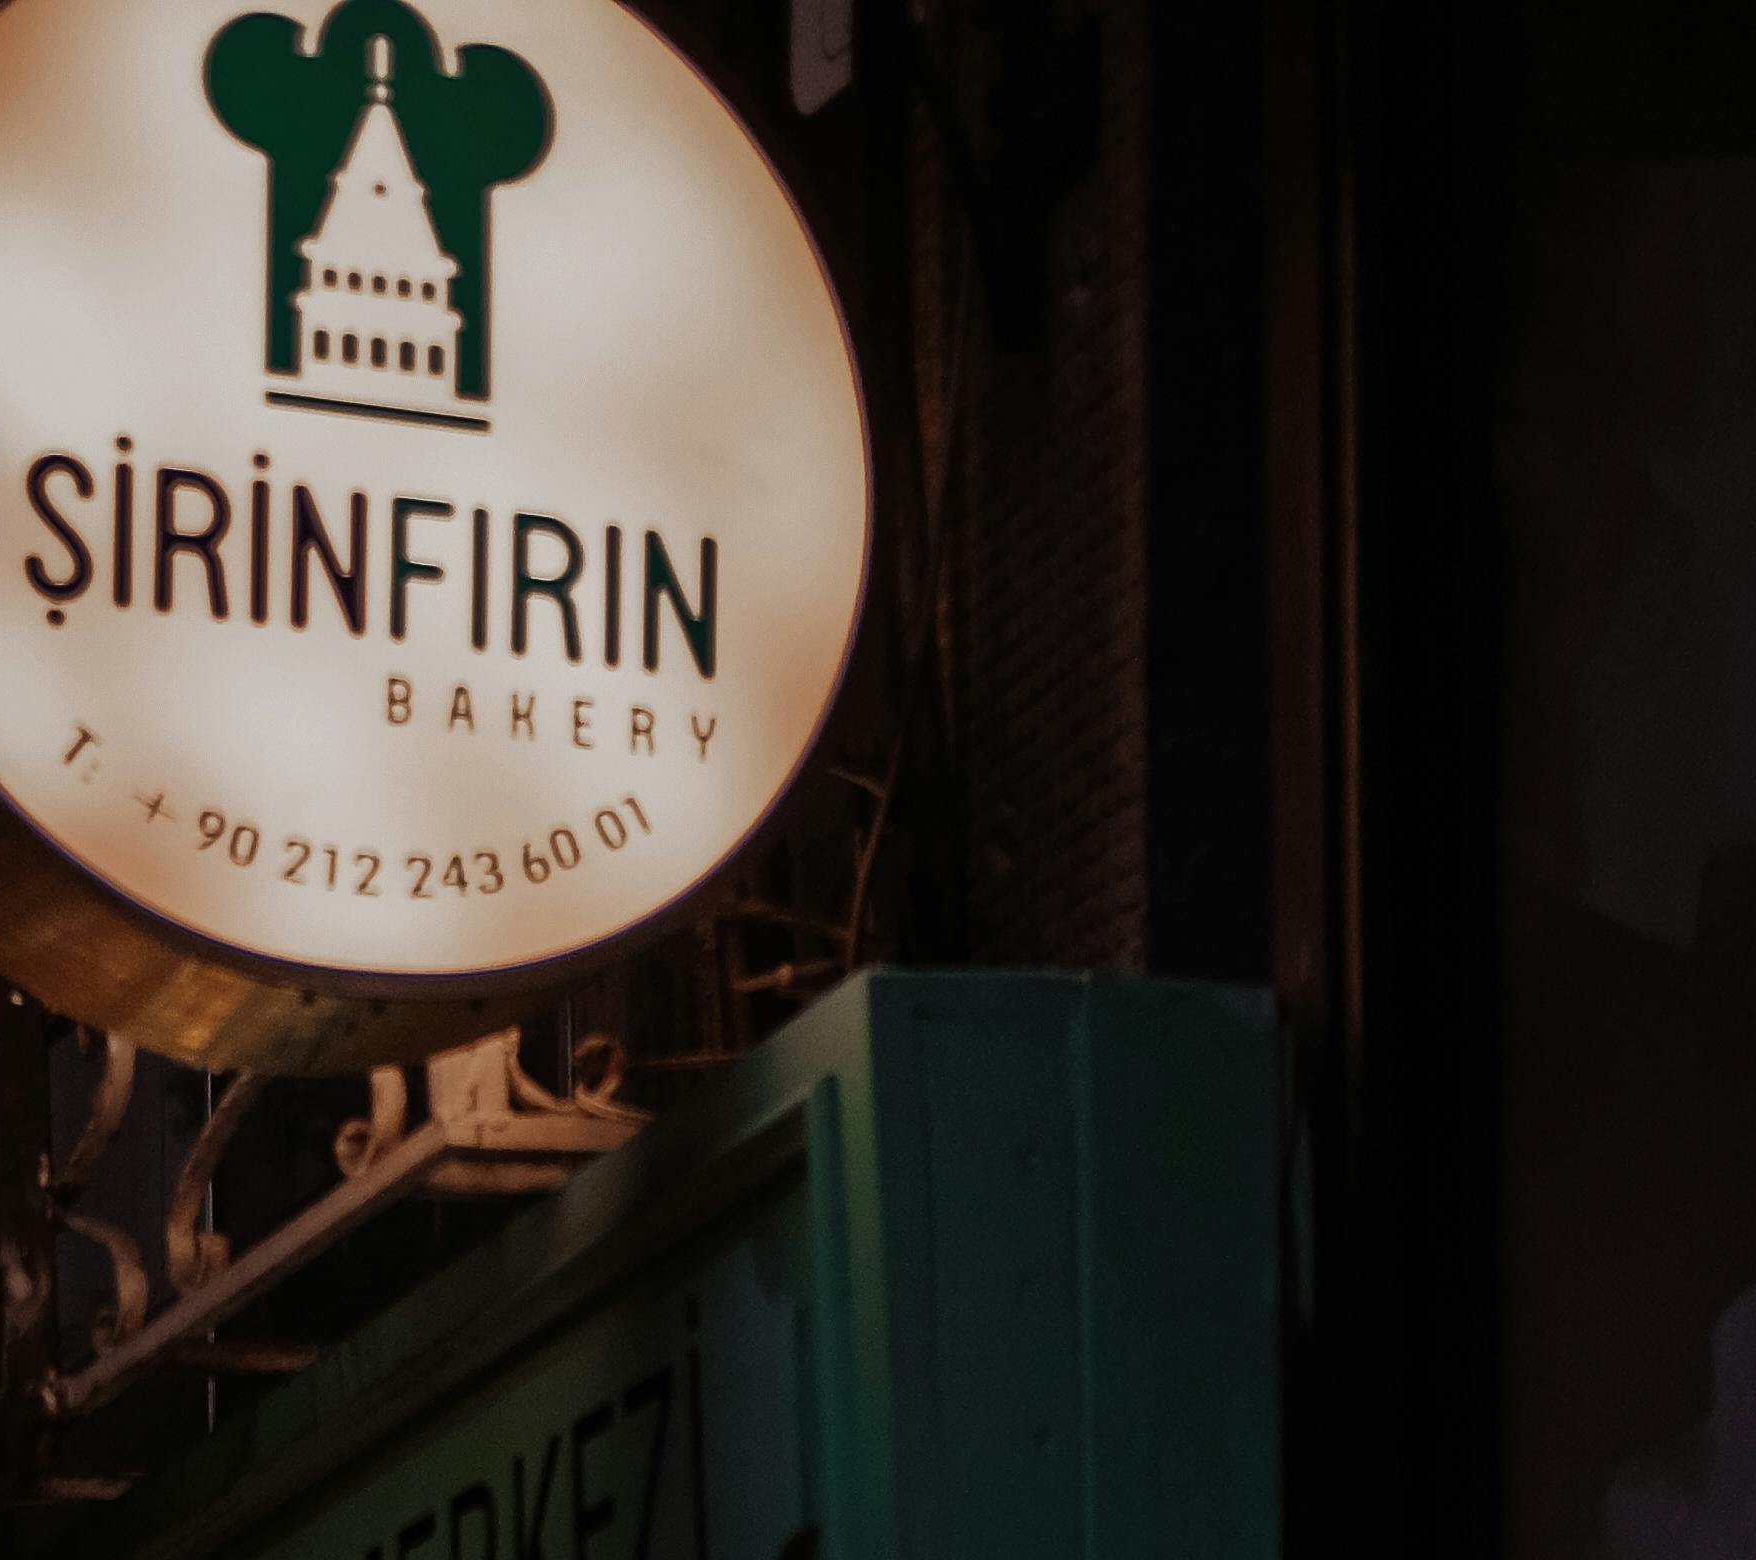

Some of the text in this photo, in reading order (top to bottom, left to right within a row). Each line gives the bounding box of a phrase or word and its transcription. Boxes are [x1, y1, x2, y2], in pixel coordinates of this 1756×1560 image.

[24, 435, 720, 680] ŞİRİNFIRIN
[387, 677, 717, 761] BAKERY
[282, 840, 382, 897] 212
[406, 851, 505, 899] 243
[522, 828, 583, 885] 60
[594, 796, 653, 852] 01
